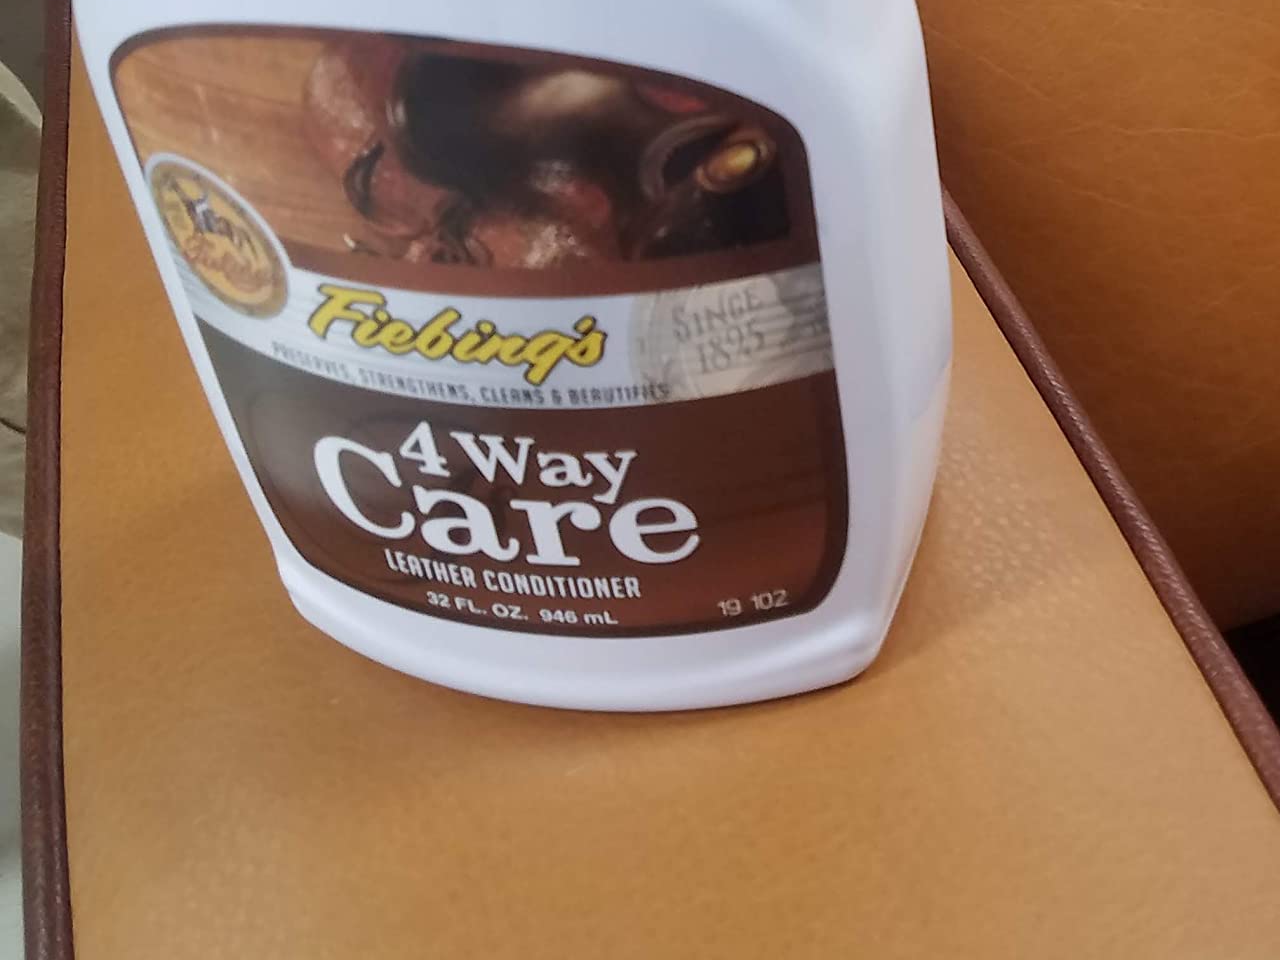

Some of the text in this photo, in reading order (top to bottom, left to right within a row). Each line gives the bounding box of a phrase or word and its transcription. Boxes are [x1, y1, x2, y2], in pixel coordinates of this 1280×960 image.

[308, 283, 608, 385] Fiebing's
[480, 386, 545, 405] CLEANS
[400, 421, 637, 504] 4 Way
[313, 436, 700, 566] Care
[385, 548, 641, 598] LEATHER CONDITIONER
[426, 591, 619, 625] 32 FL. OZ. 946 mL
[717, 589, 789, 617] 19 102
